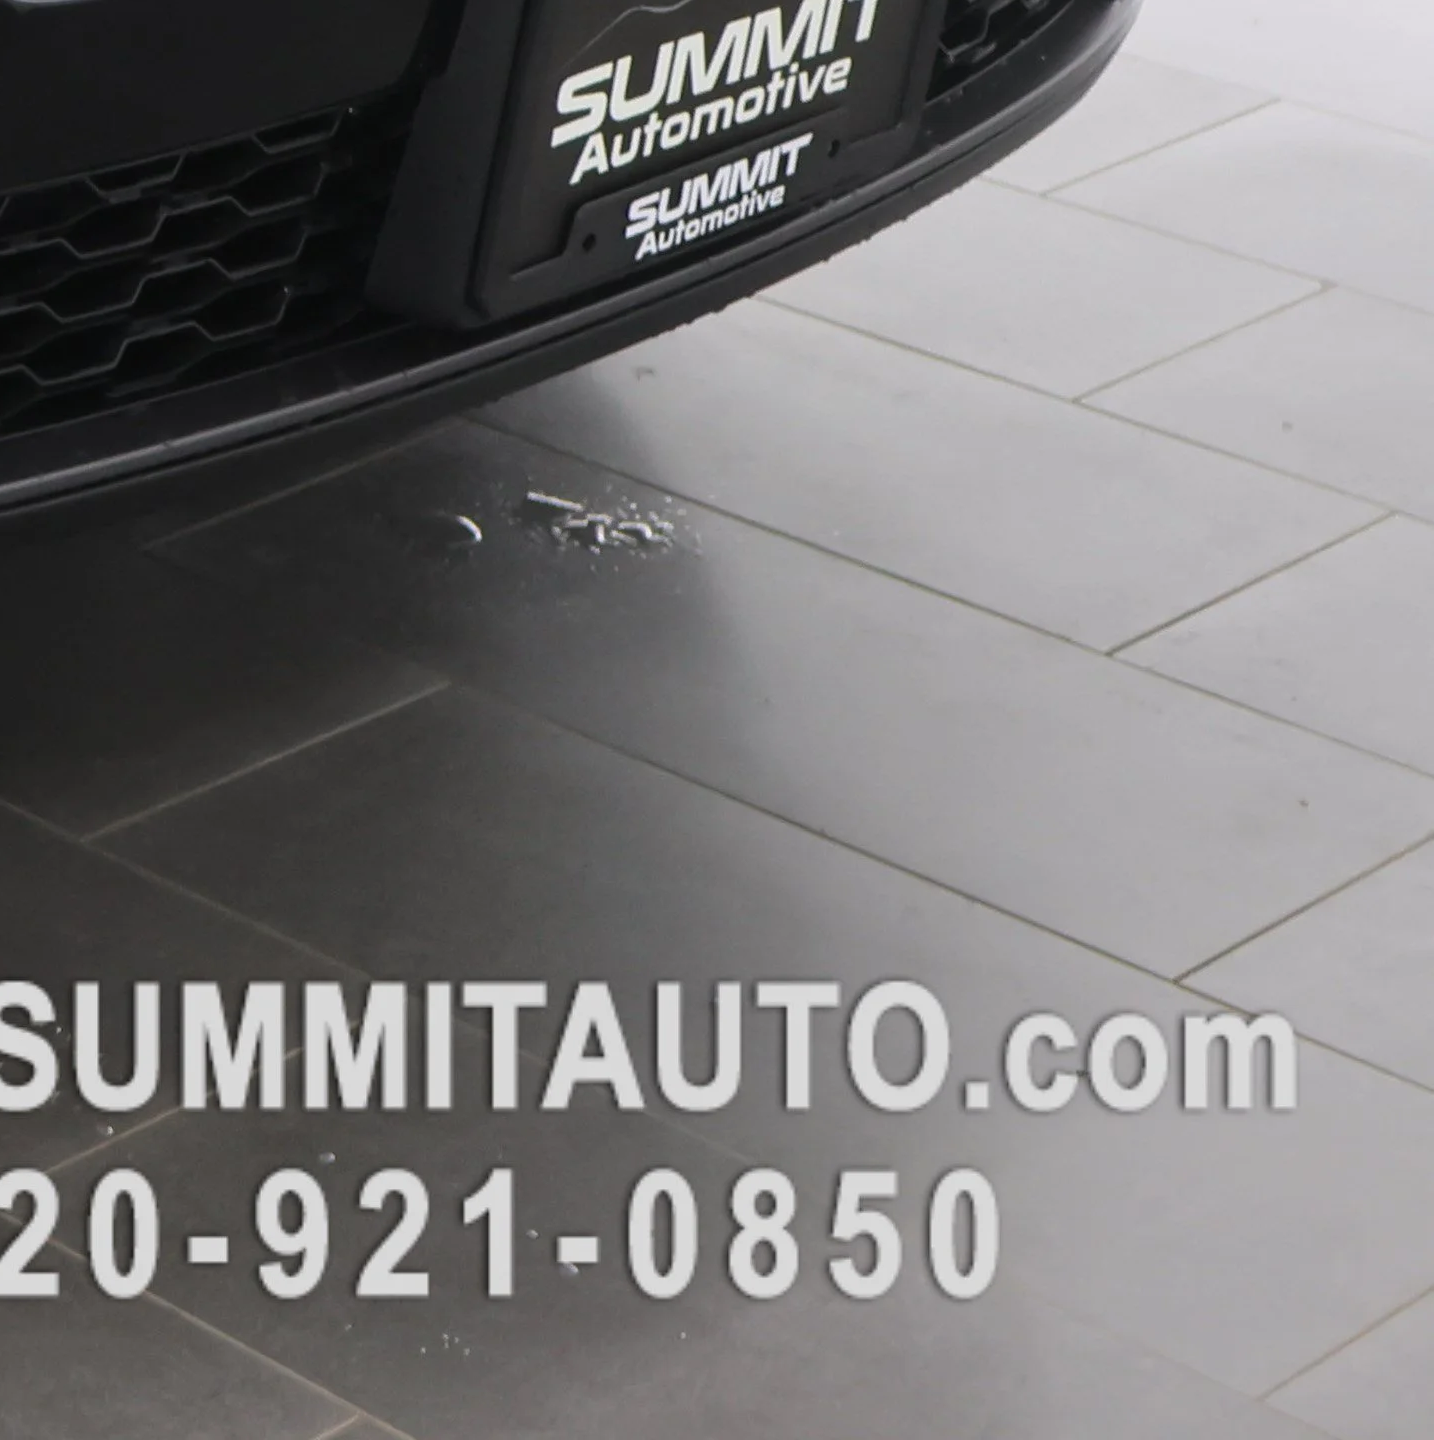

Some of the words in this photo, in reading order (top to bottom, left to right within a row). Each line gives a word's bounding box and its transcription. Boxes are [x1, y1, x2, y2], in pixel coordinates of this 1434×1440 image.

[569, 57, 852, 185] Automotive
[625, 133, 813, 239] SUMMIT
[635, 184, 785, 261] Automotive
